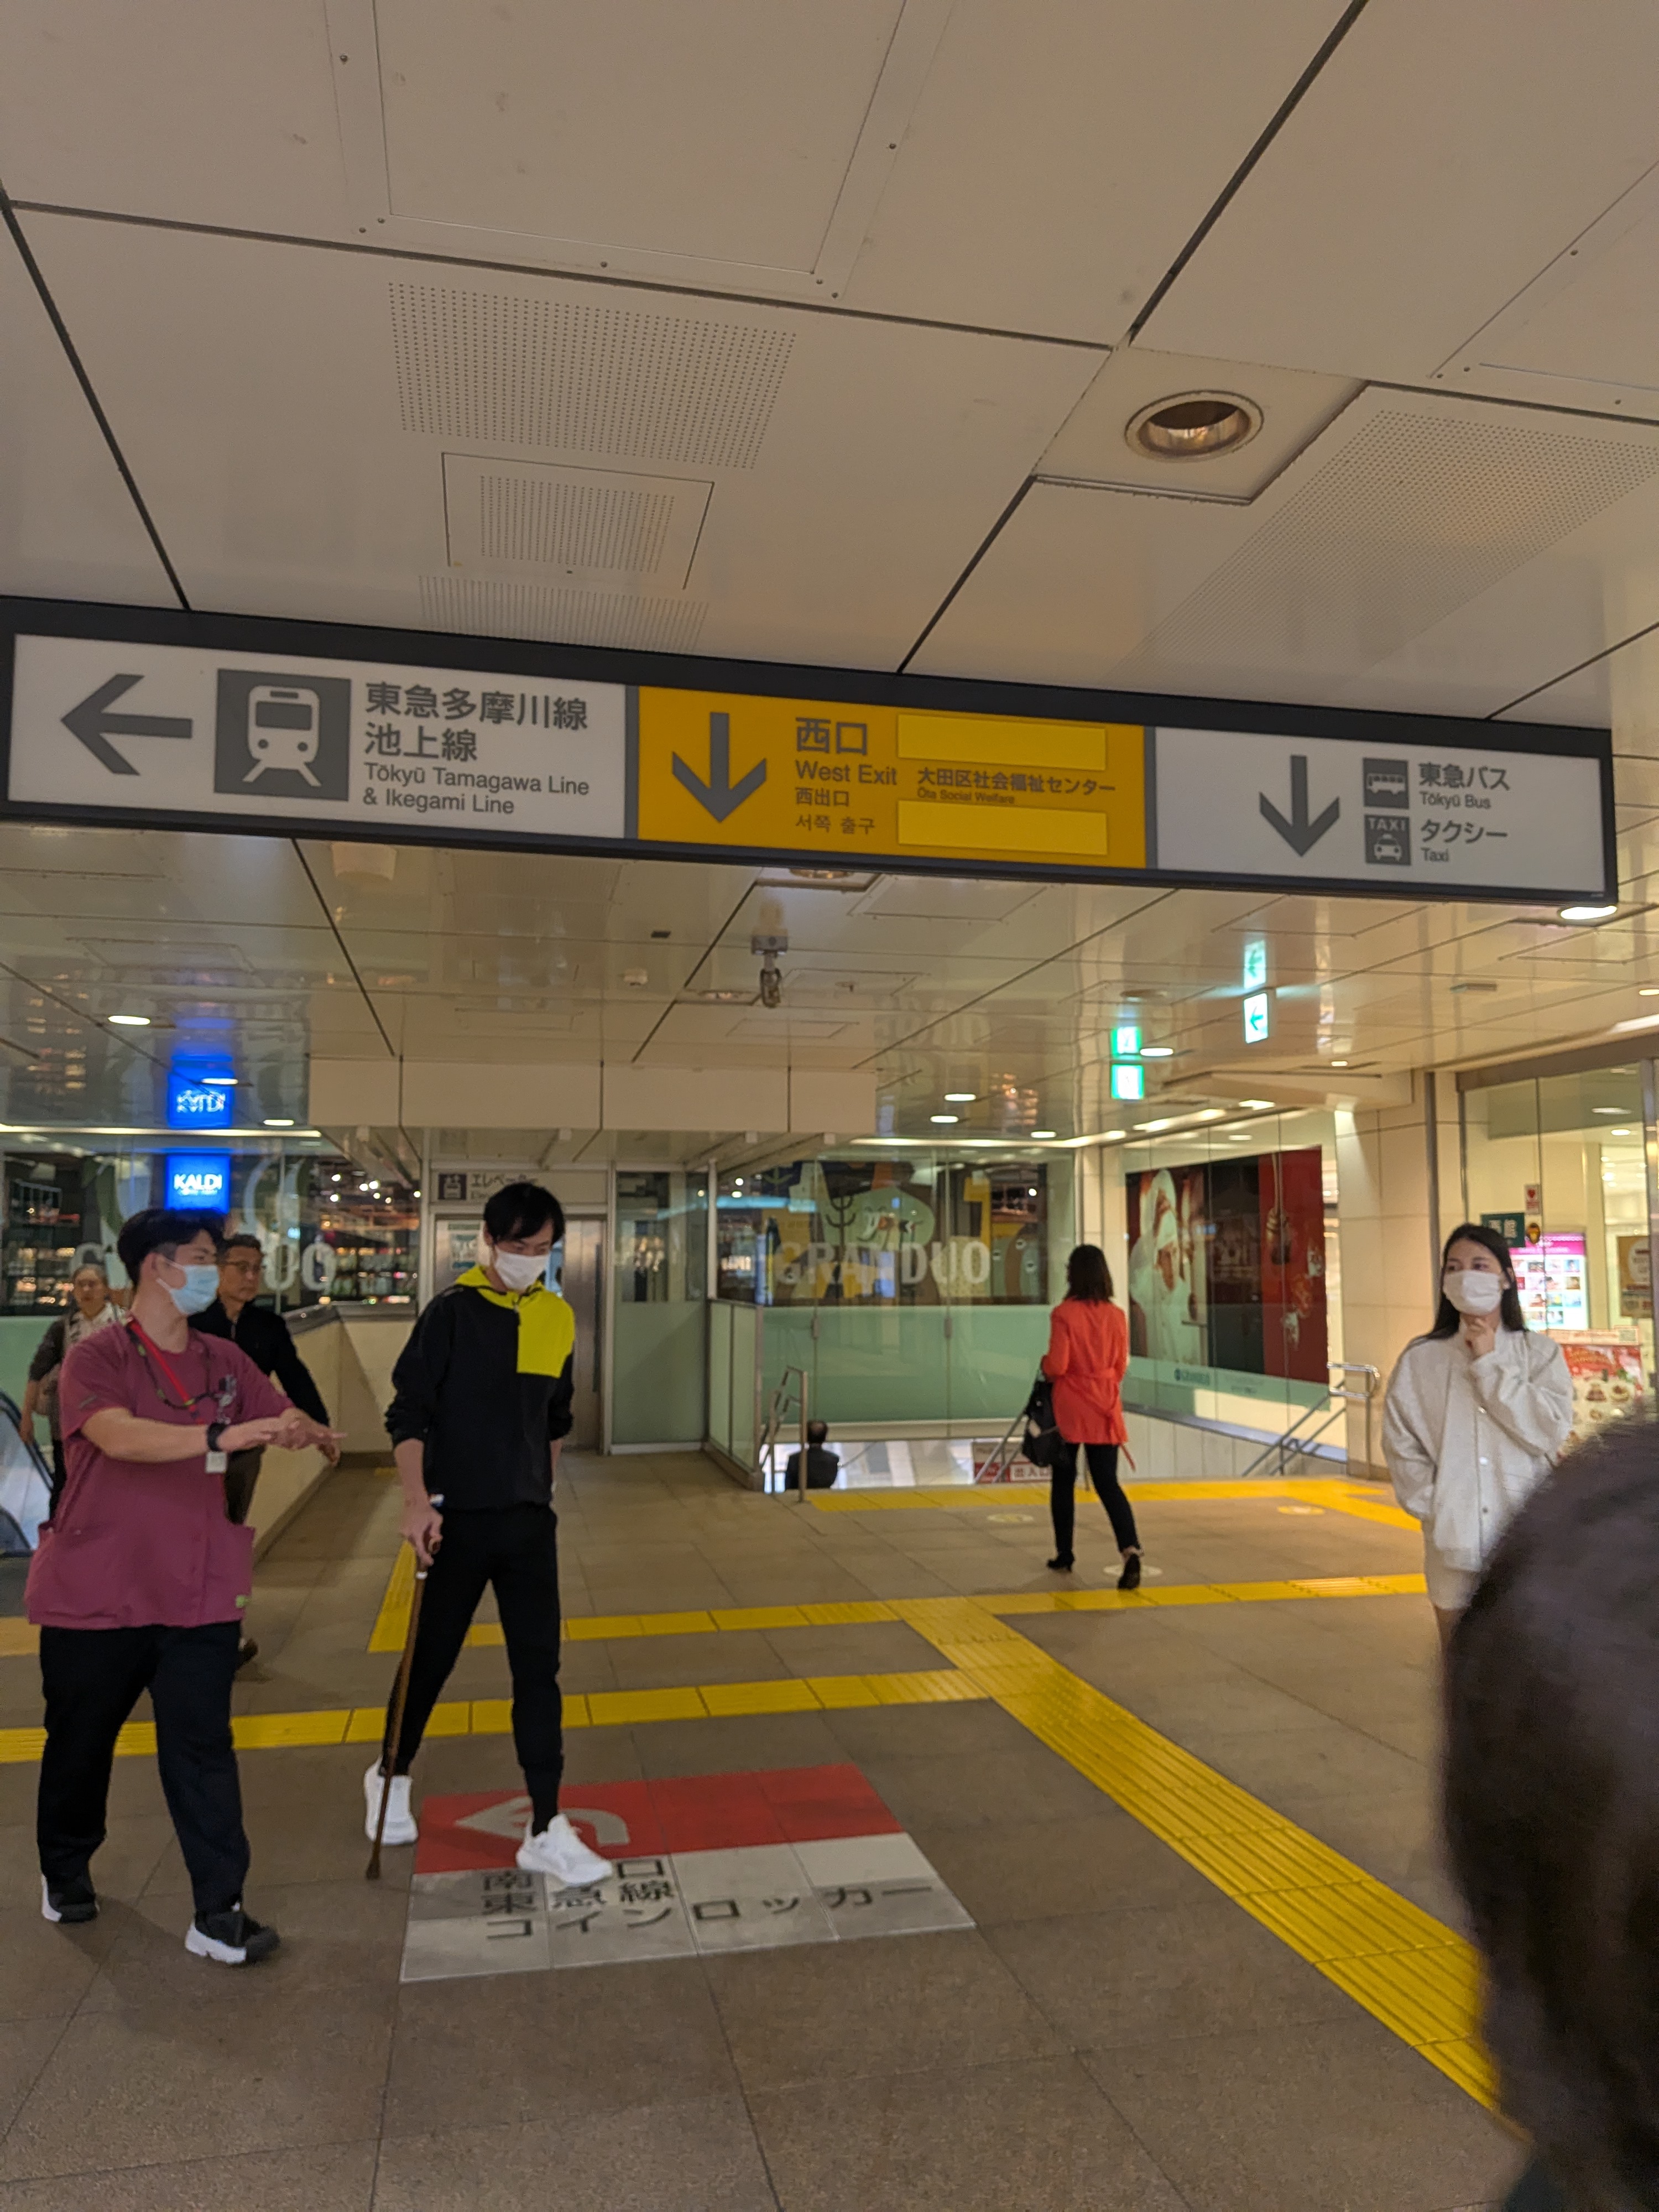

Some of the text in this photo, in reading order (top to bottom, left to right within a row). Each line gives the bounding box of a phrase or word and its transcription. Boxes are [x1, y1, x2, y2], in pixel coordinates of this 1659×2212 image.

[366, 681, 587, 731] 東急多摩川線
[366, 722, 477, 762] 池上線
[795, 717, 867, 756] 西口
[432, 766, 541, 793] Tamagawa
[549, 775, 589, 795] Line
[795, 759, 898, 785] West Exit
[1418, 762, 1510, 791] 東急バス
[363, 787, 514, 814] & Ikegami Line
[795, 787, 849, 807] 西出口
[1465, 794, 1491, 809] Bus
[841, 817, 875, 834] 출구
[1369, 817, 1406, 831] TAXI
[1421, 819, 1508, 844] タクシー
[1421, 847, 1449, 862] Taxi
[174, 1173, 222, 1190] KALDI
[487, 1886, 933, 1940] コインロッカー
